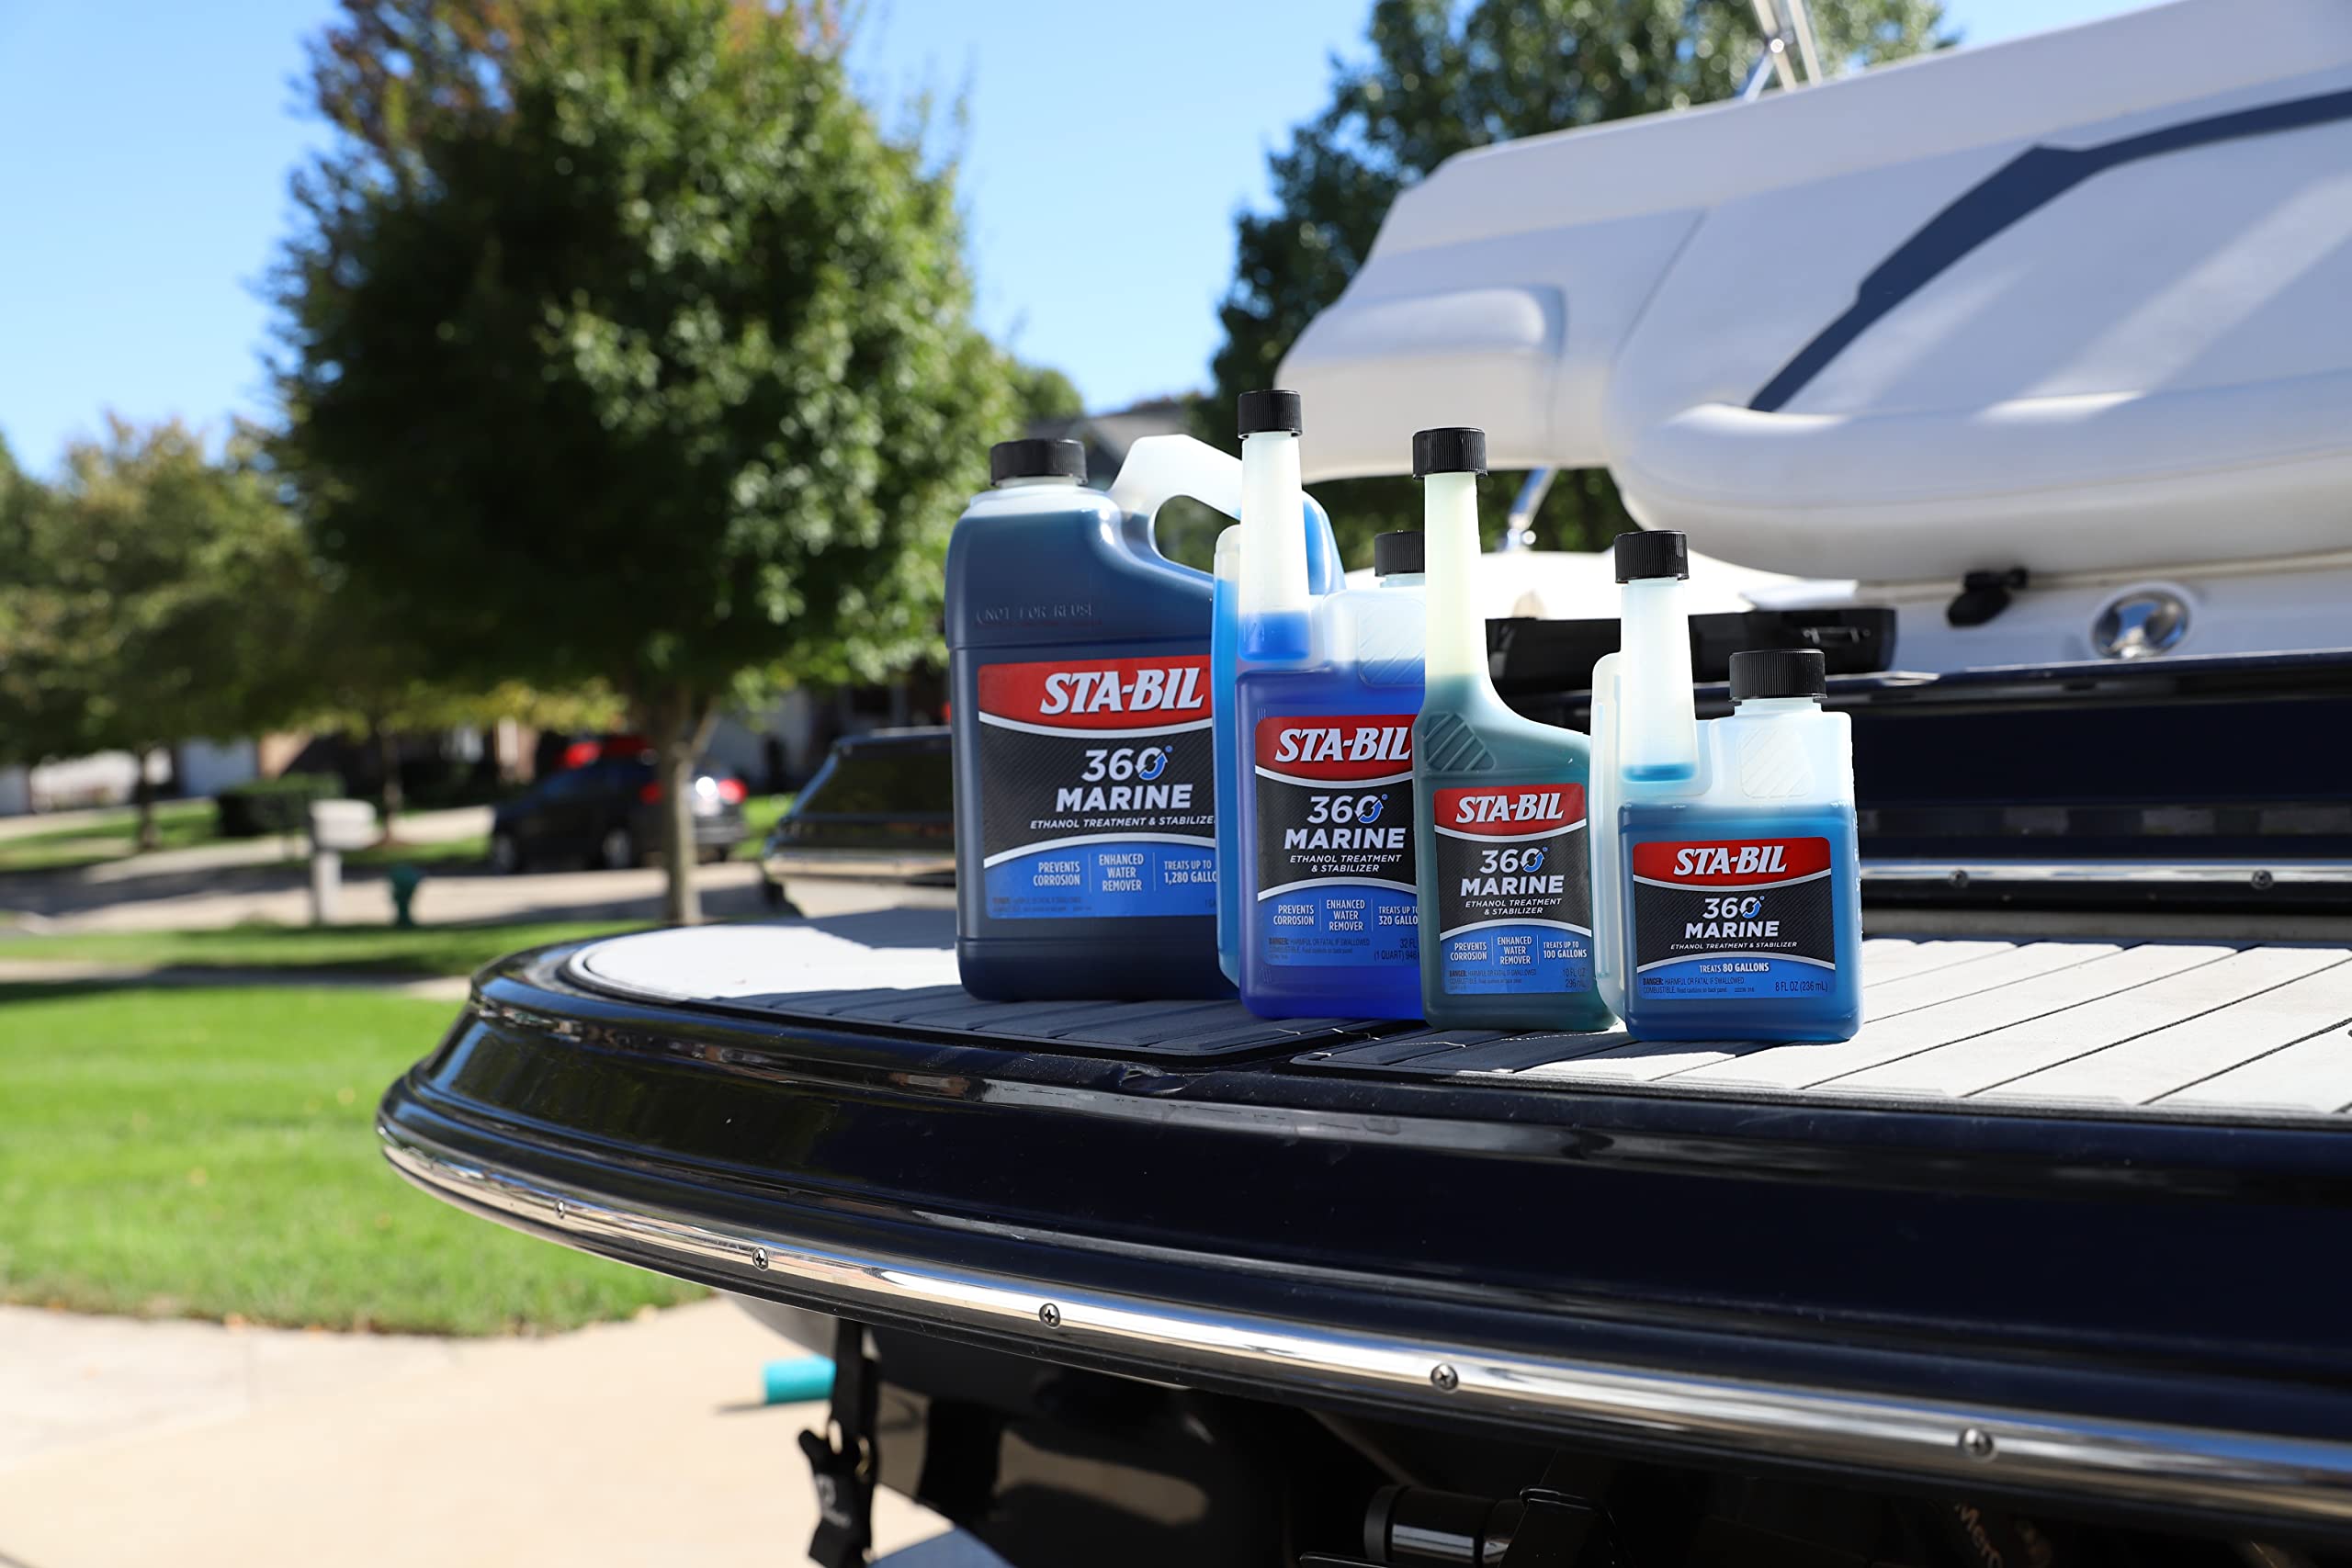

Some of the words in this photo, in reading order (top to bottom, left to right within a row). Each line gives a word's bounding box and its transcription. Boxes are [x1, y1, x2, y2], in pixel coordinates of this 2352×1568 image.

[1040, 667, 1204, 715] STA-BIL
[1275, 727, 1412, 762] STA-BIL
[1057, 784, 1193, 812] MARINE
[1455, 793, 1564, 824] STA-BIL
[1030, 819, 1080, 829] ETHANOL
[1083, 817, 1146, 828] TREATMENT
[1148, 817, 1157, 826] &
[1159, 816, 1216, 825] STABILIZE
[1284, 828, 1406, 850] MARINE
[1099, 853, 1144, 867] ENHANCED
[1290, 855, 1338, 863] ETHANOL
[1340, 854, 1401, 863] TREATMENT
[1673, 845, 1787, 875] STA-BIL
[1038, 861, 1080, 874] PREVENTS
[1164, 860, 1190, 871] TREATS
[1191, 860, 1201, 870] UP
[1203, 860, 1212, 870] TO
[1311, 864, 1318, 873] &
[1321, 864, 1379, 873] STABILIZER
[1107, 866, 1136, 879] WATER
[1033, 874, 1080, 886] CORROSION
[1164, 872, 1189, 886] 1,280
[1102, 879, 1142, 892] REMOVER
[1461, 875, 1564, 896] MARINE
[1326, 899, 1365, 910] ENHANCED
[1465, 899, 1506, 908] ETHANOL
[1510, 897, 1562, 906] TREATMENT
[1278, 905, 1314, 916] PREVENTS
[1378, 906, 1400, 914] TREATS
[1402, 906, 1410, 914] UP
[1492, 907, 1544, 915] STABILIZER
[1273, 915, 1314, 926] CORROSION
[1333, 911, 1359, 921] WATER
[1378, 915, 1392, 925] 320
[1329, 921, 1363, 931] REMOVER
[1685, 920, 1780, 938] MARINE
[1400, 938, 1408, 948] 32
[1409, 938, 1417, 948] FL
[1454, 942, 1487, 952] PREVENTS
[1498, 937, 1532, 946] ENHANCED
[1544, 942, 1562, 950] TREATS
[1563, 942, 1570, 950] UP
[1381, 950, 1404, 962] QUART)
[1451, 951, 1487, 961] CORROSION
[1504, 946, 1526, 955] WATER
[1544, 950, 1555, 958] 100
[1557, 950, 1587, 958] GALLONS
[1499, 955, 1531, 964] REMOVER
[1700, 964, 1721, 973] TREATS
[1723, 964, 1734, 973] 80
[1735, 963, 1770, 972] GALLONS
[1566, 979, 1577, 987] 296
[1775, 980, 1781, 991] 8
[1781, 980, 1789, 991] FL
[1790, 980, 1799, 991] OZ
[1800, 980, 1814, 992] (236
[1815, 979, 1827, 992] mL)
